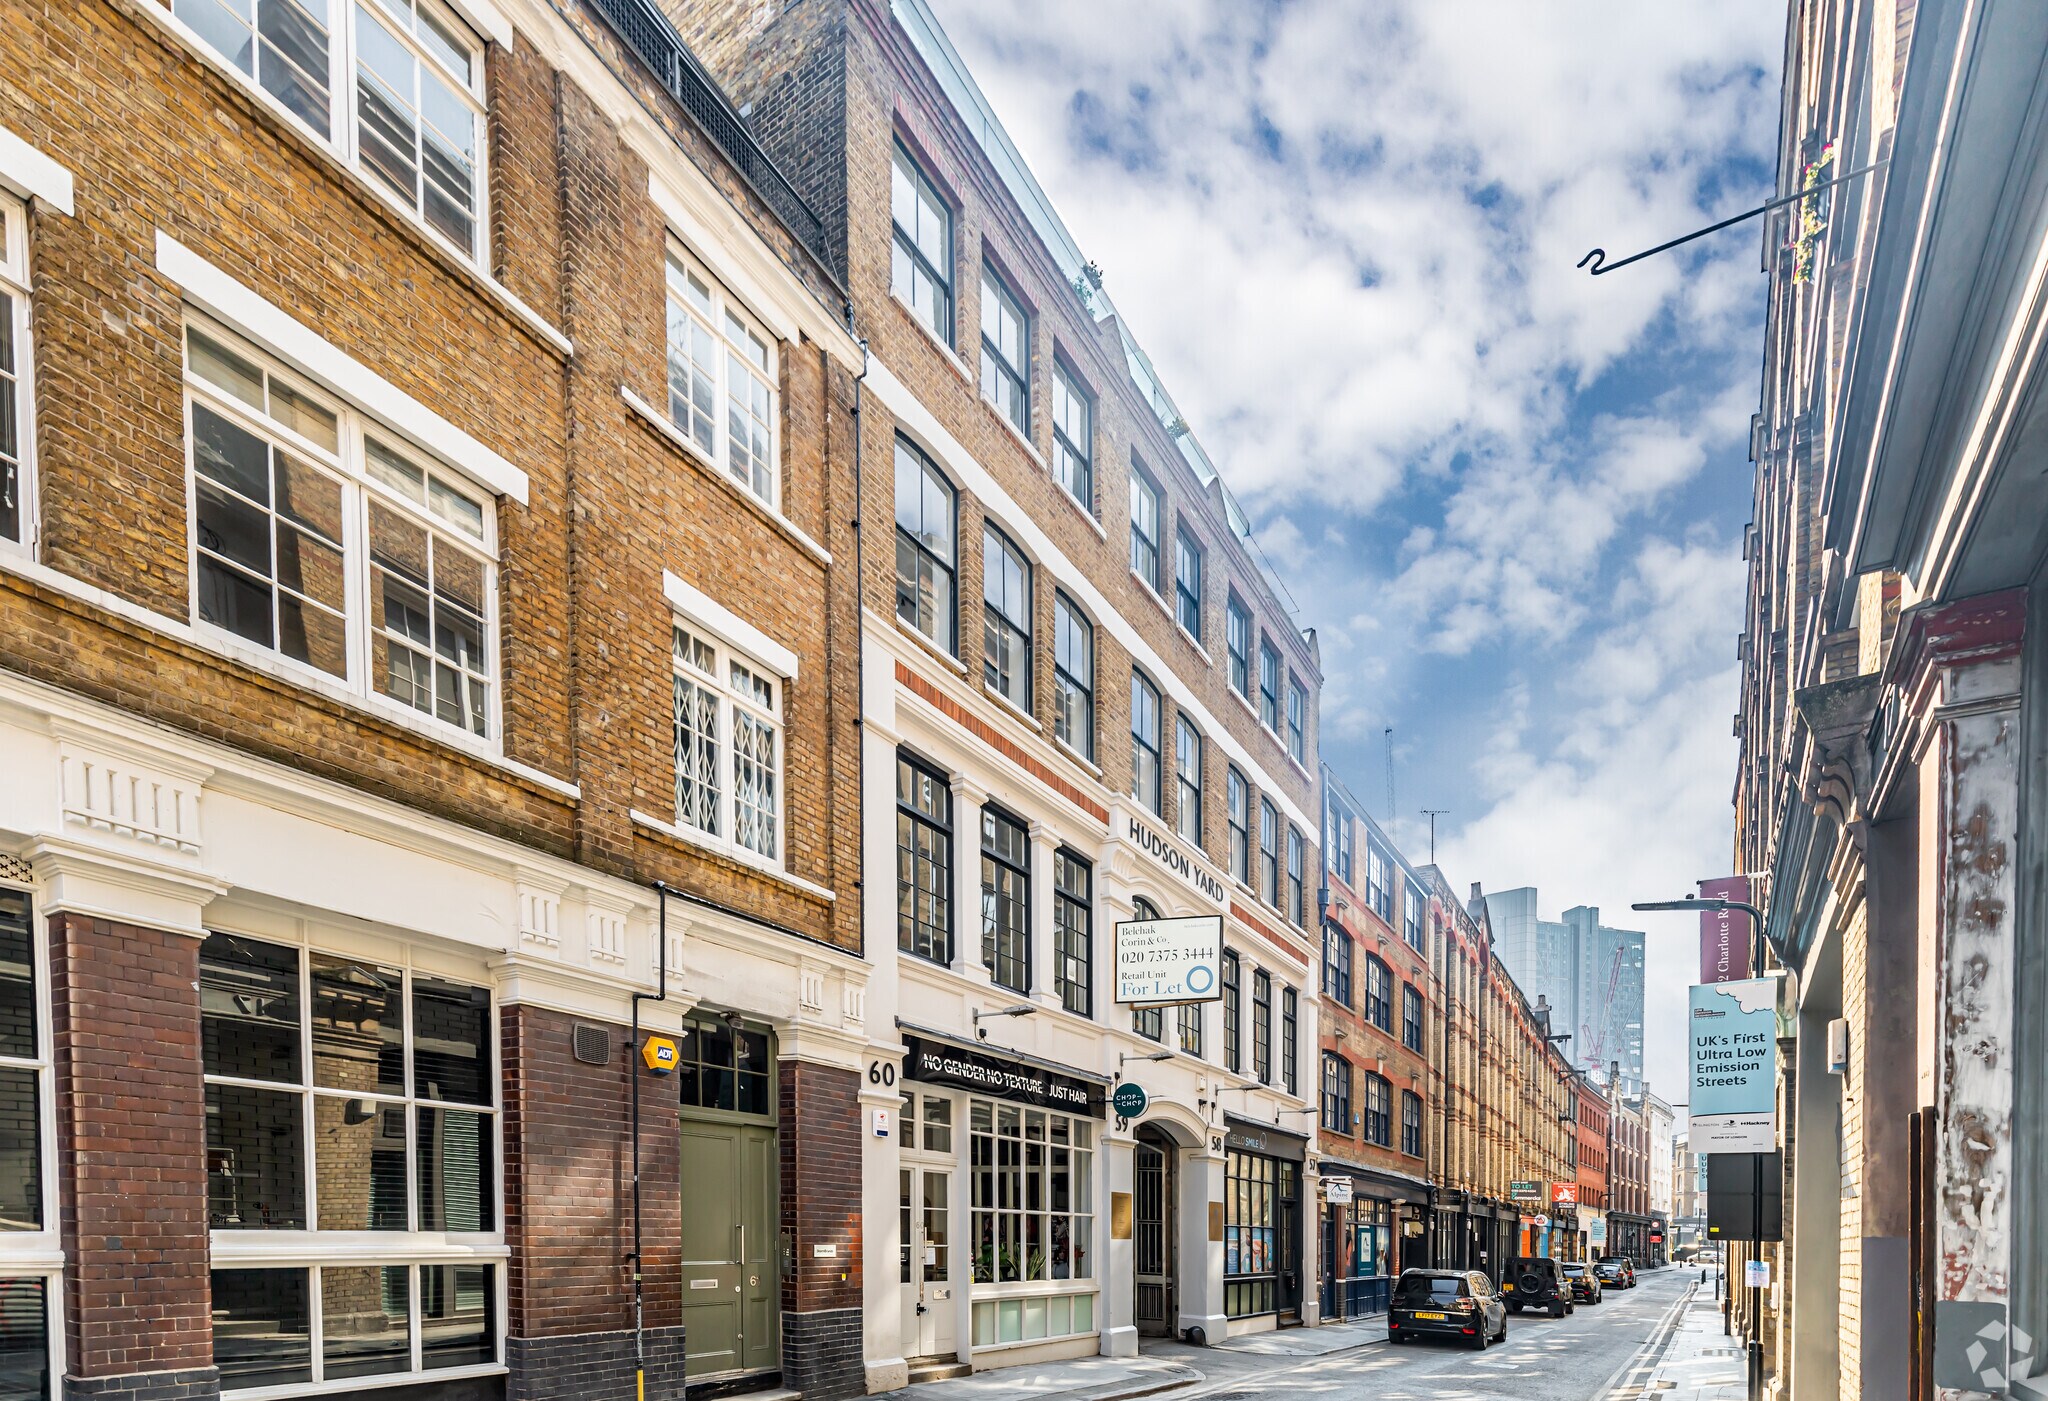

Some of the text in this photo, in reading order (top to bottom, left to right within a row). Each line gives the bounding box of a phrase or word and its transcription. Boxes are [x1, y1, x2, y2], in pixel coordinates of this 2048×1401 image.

[1129, 817, 1224, 903] HUDSON YARD
[1717, 890, 1729, 920] Rd
[1122, 925, 1156, 936] Belchak
[1121, 938, 1146, 947] Corin
[1147, 937, 1155, 945] &
[1717, 922, 1729, 973] Charlotte
[1121, 946, 1214, 964] 020 7375 3444
[1121, 970, 1167, 980] Retail Unit
[1121, 981, 1182, 996] For Let
[1696, 1032, 1765, 1047] UK's First
[658, 1048, 673, 1060] ADT
[1696, 1048, 1767, 1061] Ultra Low
[869, 1060, 895, 1087] 60
[1696, 1061, 1759, 1074] Emission
[923, 1053, 1088, 1105] NO GENDER NO TEXTURE JUST HAIR
[1696, 1075, 1747, 1087] Streets
[1115, 1114, 1129, 1133] 59
[1211, 1136, 1222, 1151] 58
[1229, 1133, 1259, 1149] HELLO SMILE
[1309, 1158, 1316, 1170] 57
